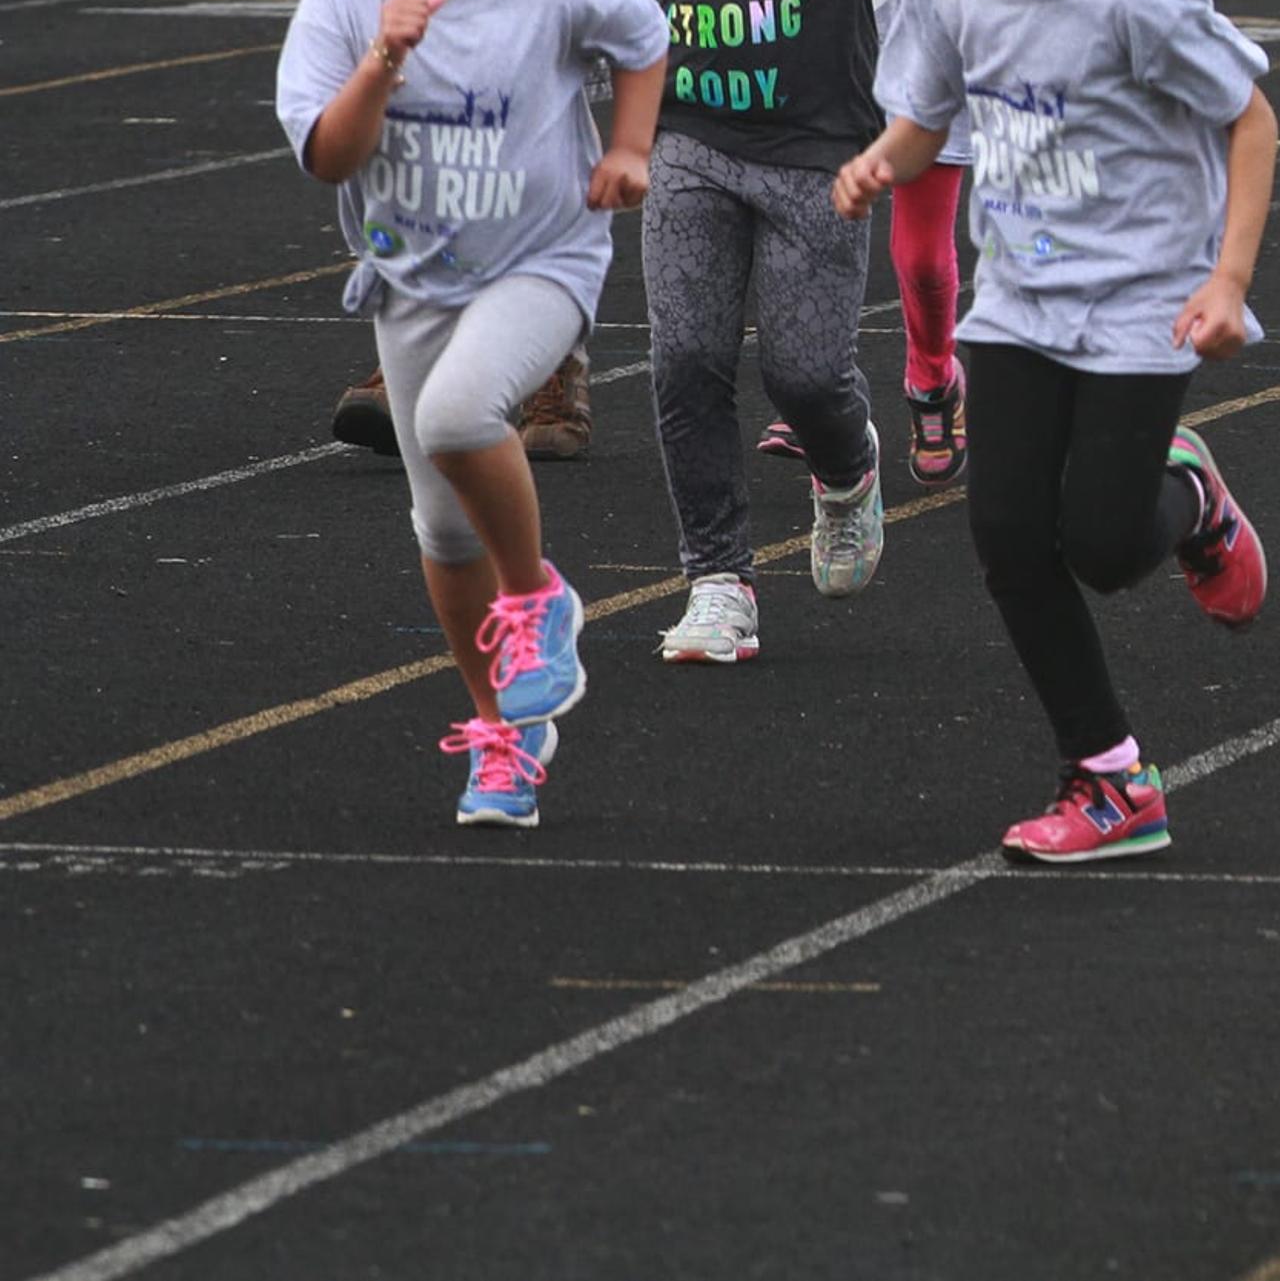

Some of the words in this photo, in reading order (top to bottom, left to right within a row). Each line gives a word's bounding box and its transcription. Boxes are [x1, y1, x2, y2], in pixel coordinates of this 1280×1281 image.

[430, 126, 507, 168] WHY
[971, 131, 1012, 191] OU
[369, 158, 423, 211] OU
[435, 170, 526, 221] RUN
